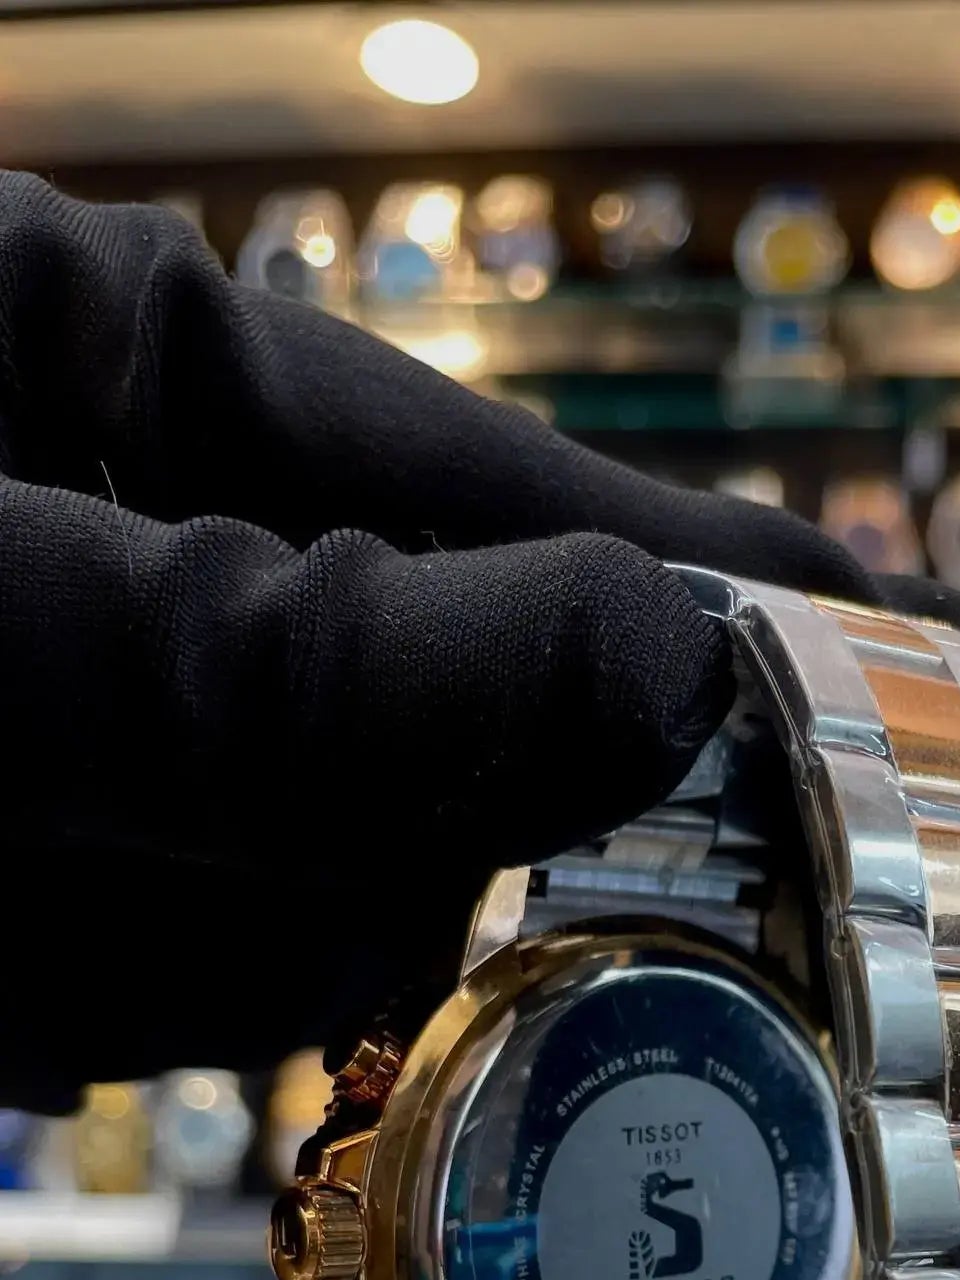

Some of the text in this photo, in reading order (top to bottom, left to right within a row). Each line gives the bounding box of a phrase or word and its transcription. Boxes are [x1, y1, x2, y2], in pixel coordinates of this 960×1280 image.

[556, 1047, 679, 1118] STAINLESS STEEL
[621, 1122, 703, 1146] TISSOT
[646, 1148, 682, 1166] 1853
[516, 1144, 546, 1222] CRYSTAL
